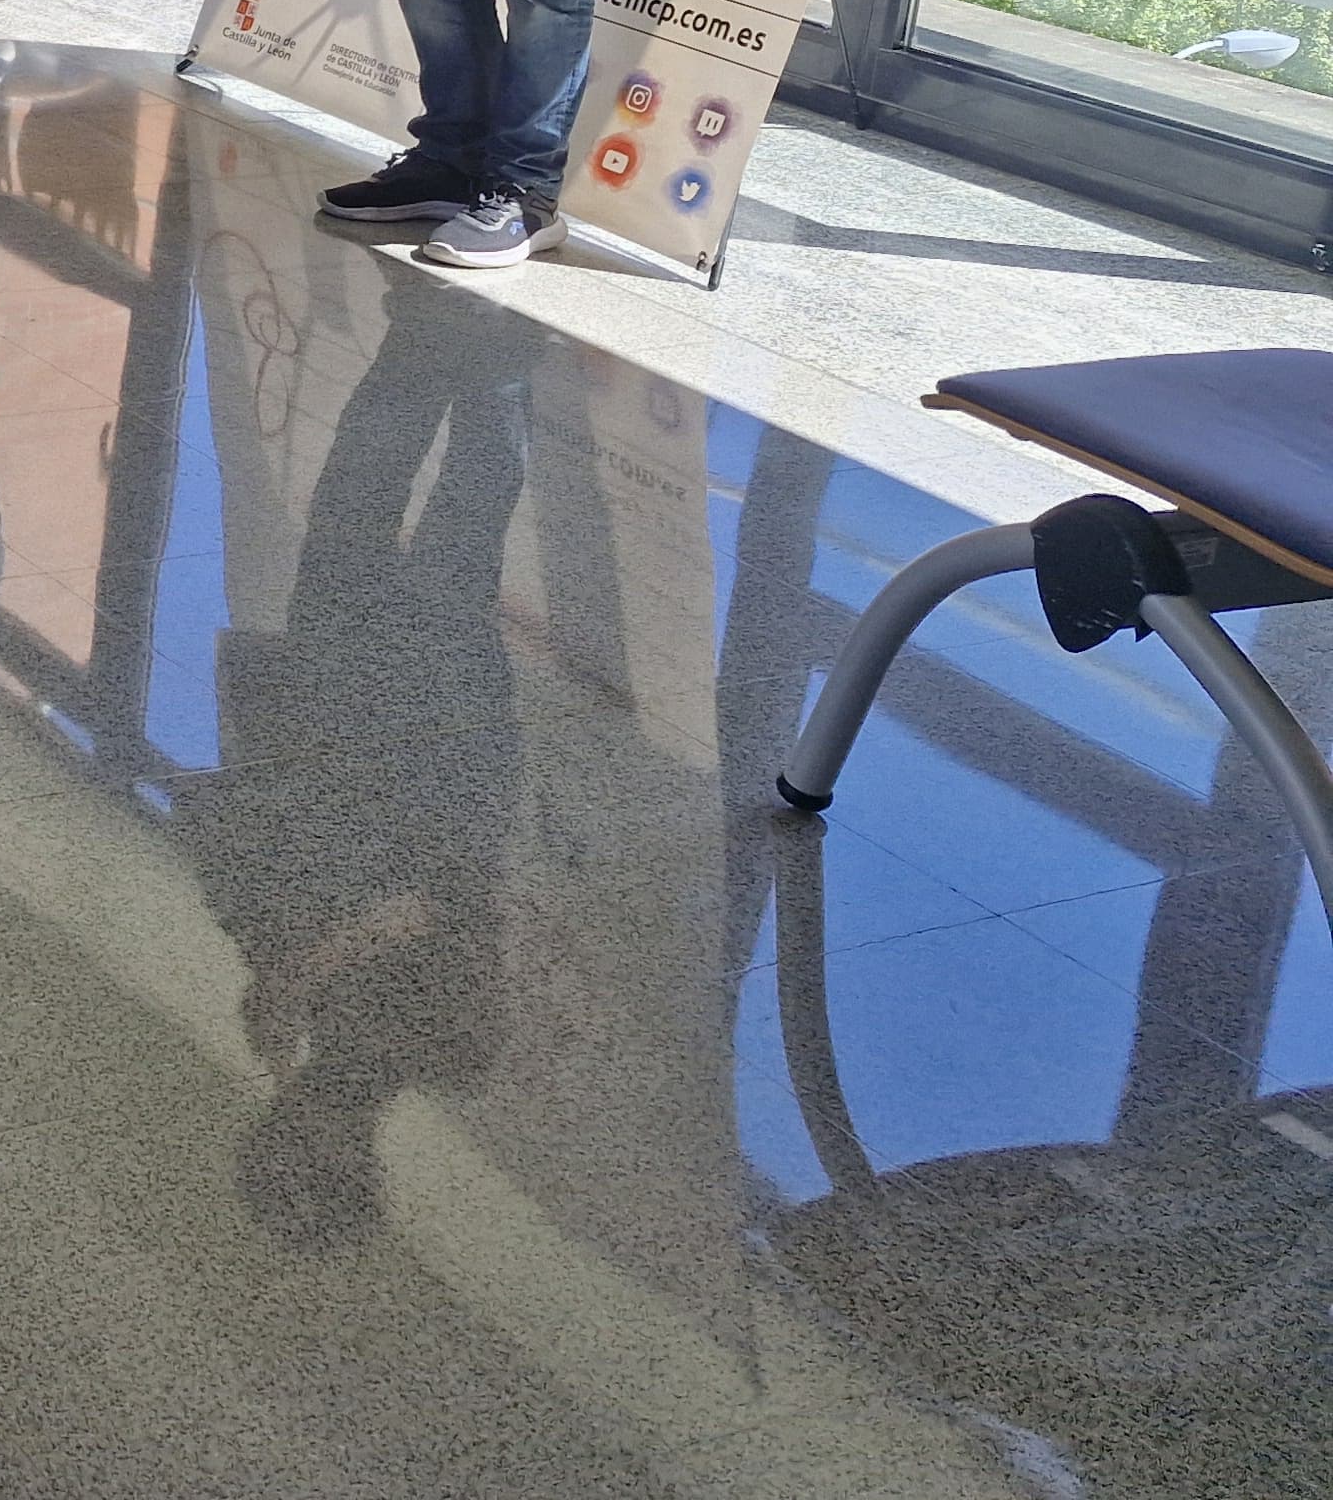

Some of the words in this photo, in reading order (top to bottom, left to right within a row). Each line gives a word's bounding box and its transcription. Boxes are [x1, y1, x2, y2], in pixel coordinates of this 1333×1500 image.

[222, 26, 257, 47] Castilla
[257, 42, 265, 53] y
[267, 43, 292, 60] León
[253, 25, 281, 43] Junta
[283, 37, 296, 49] de
[326, 54, 336, 63] de
[337, 57, 373, 78] CASTILLA
[330, 43, 378, 67] DIRECTORIO
[377, 62, 387, 71] de
